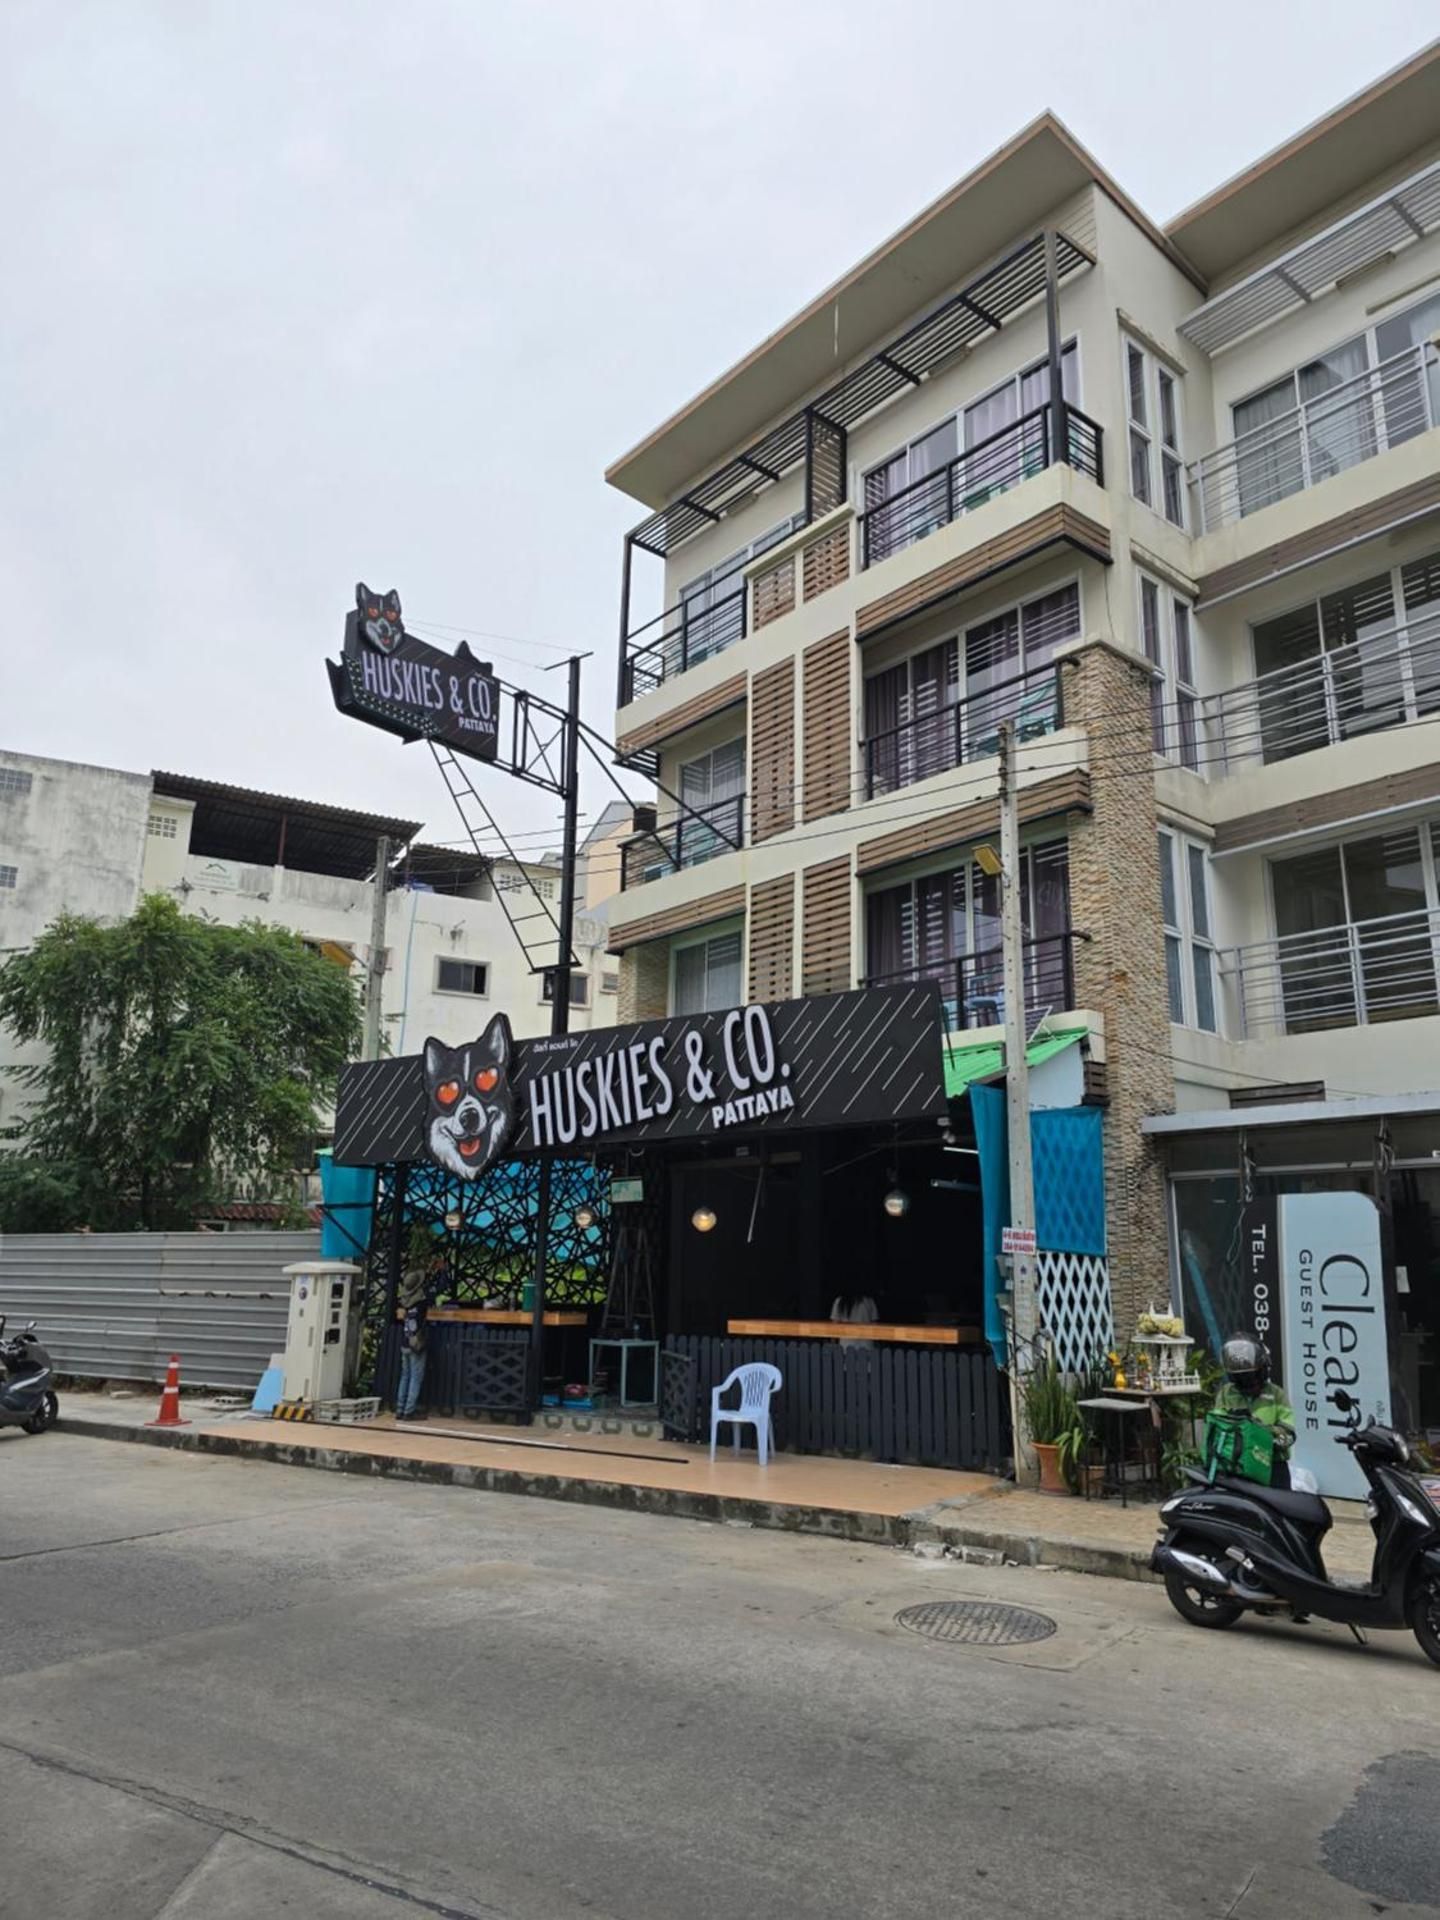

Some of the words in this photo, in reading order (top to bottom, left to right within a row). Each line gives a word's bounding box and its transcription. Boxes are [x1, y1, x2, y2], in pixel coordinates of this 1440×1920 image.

[361, 650, 445, 711] HUSKIES
[450, 676, 464, 714] &
[468, 678, 498, 721] CO.
[458, 716, 495, 735] PATTAYA
[529, 1036, 673, 1146] HUSKIES
[684, 1030, 716, 1104] &
[723, 1004, 791, 1091] CO.
[711, 1084, 795, 1129] PATTAYA
[1251, 1223, 1267, 1274] TEL.
[1299, 1249, 1314, 1329] GUEST
[1303, 1343, 1319, 1431] HOUSE
